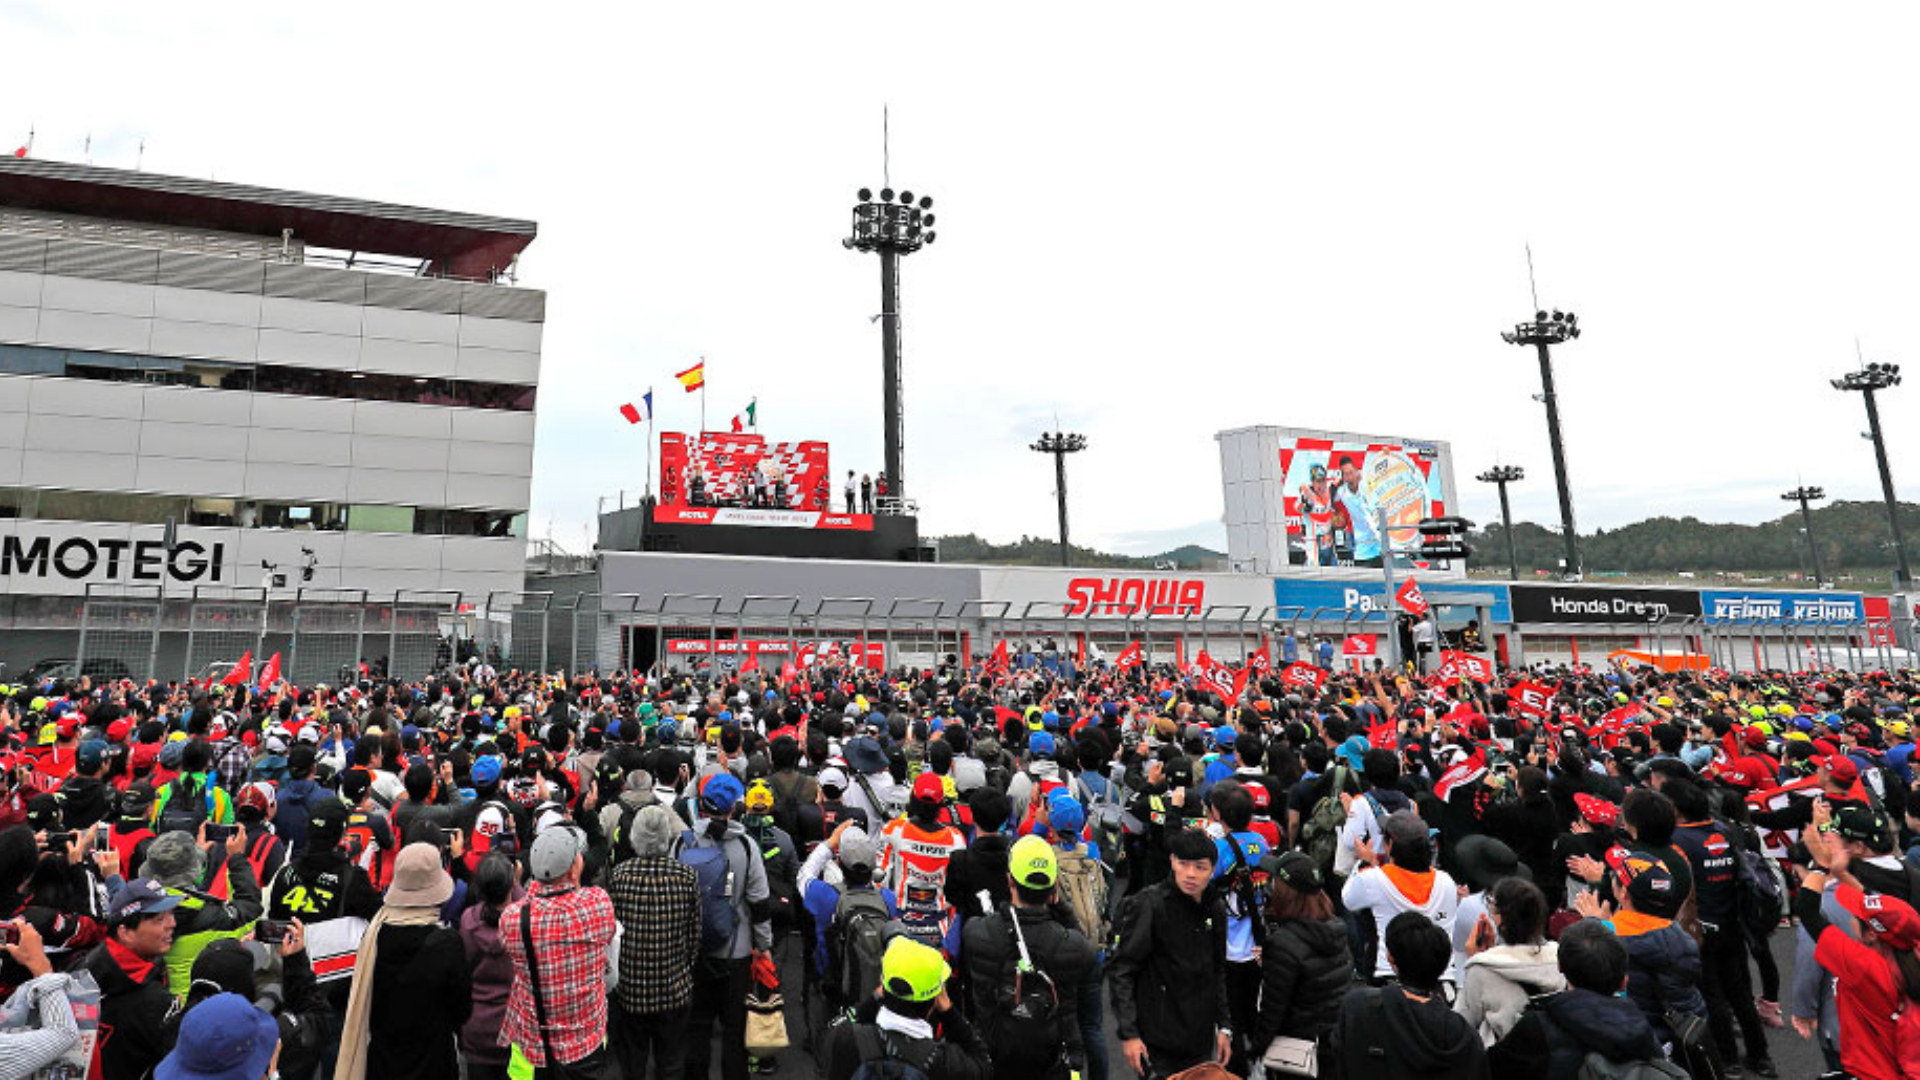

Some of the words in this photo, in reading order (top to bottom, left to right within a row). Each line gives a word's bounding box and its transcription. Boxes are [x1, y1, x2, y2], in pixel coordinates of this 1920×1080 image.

[0, 535, 224, 581] MOTEGI
[1063, 578, 1204, 615] SHOWA
[1551, 597, 1609, 613] Honda
[1714, 596, 1782, 619] KEIHIN
[1794, 597, 1858, 619] KEIHIN
[718, 643, 749, 651] MOTL
